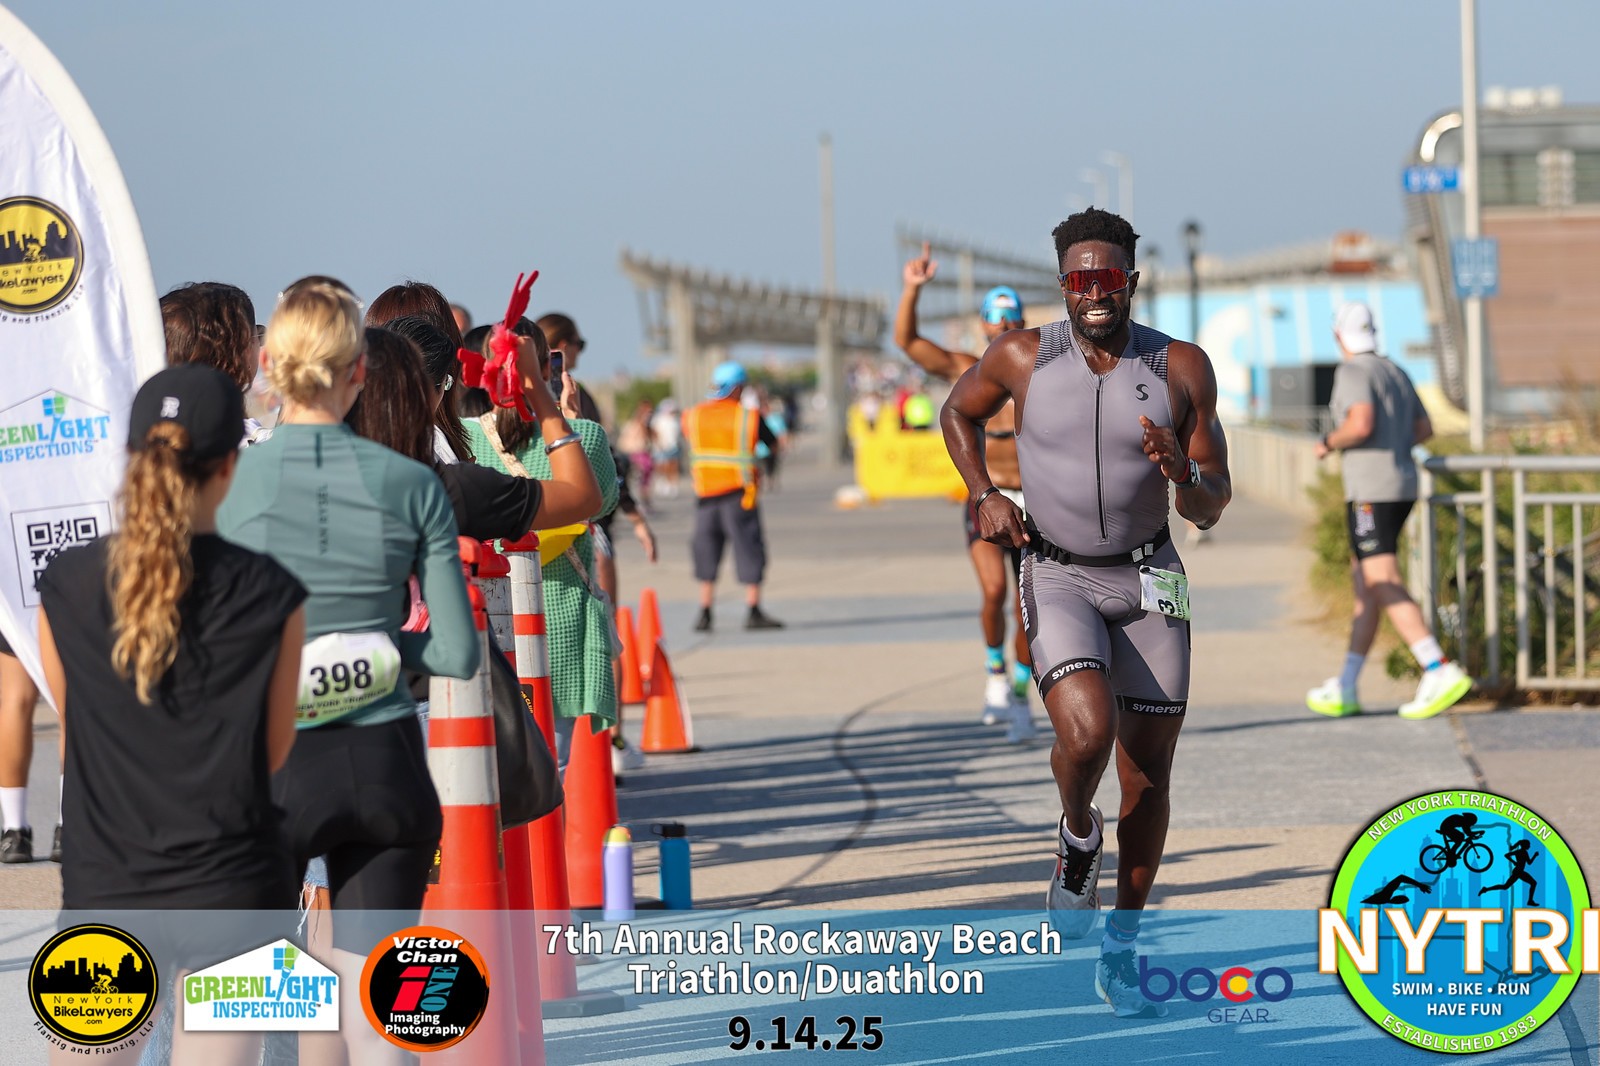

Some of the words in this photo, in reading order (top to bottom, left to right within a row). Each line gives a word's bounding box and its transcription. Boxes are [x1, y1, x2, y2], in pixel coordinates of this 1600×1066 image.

[310, 658, 372, 697] 398
[1051, 661, 1101, 681] synergy
[1132, 703, 1184, 714] synergy
